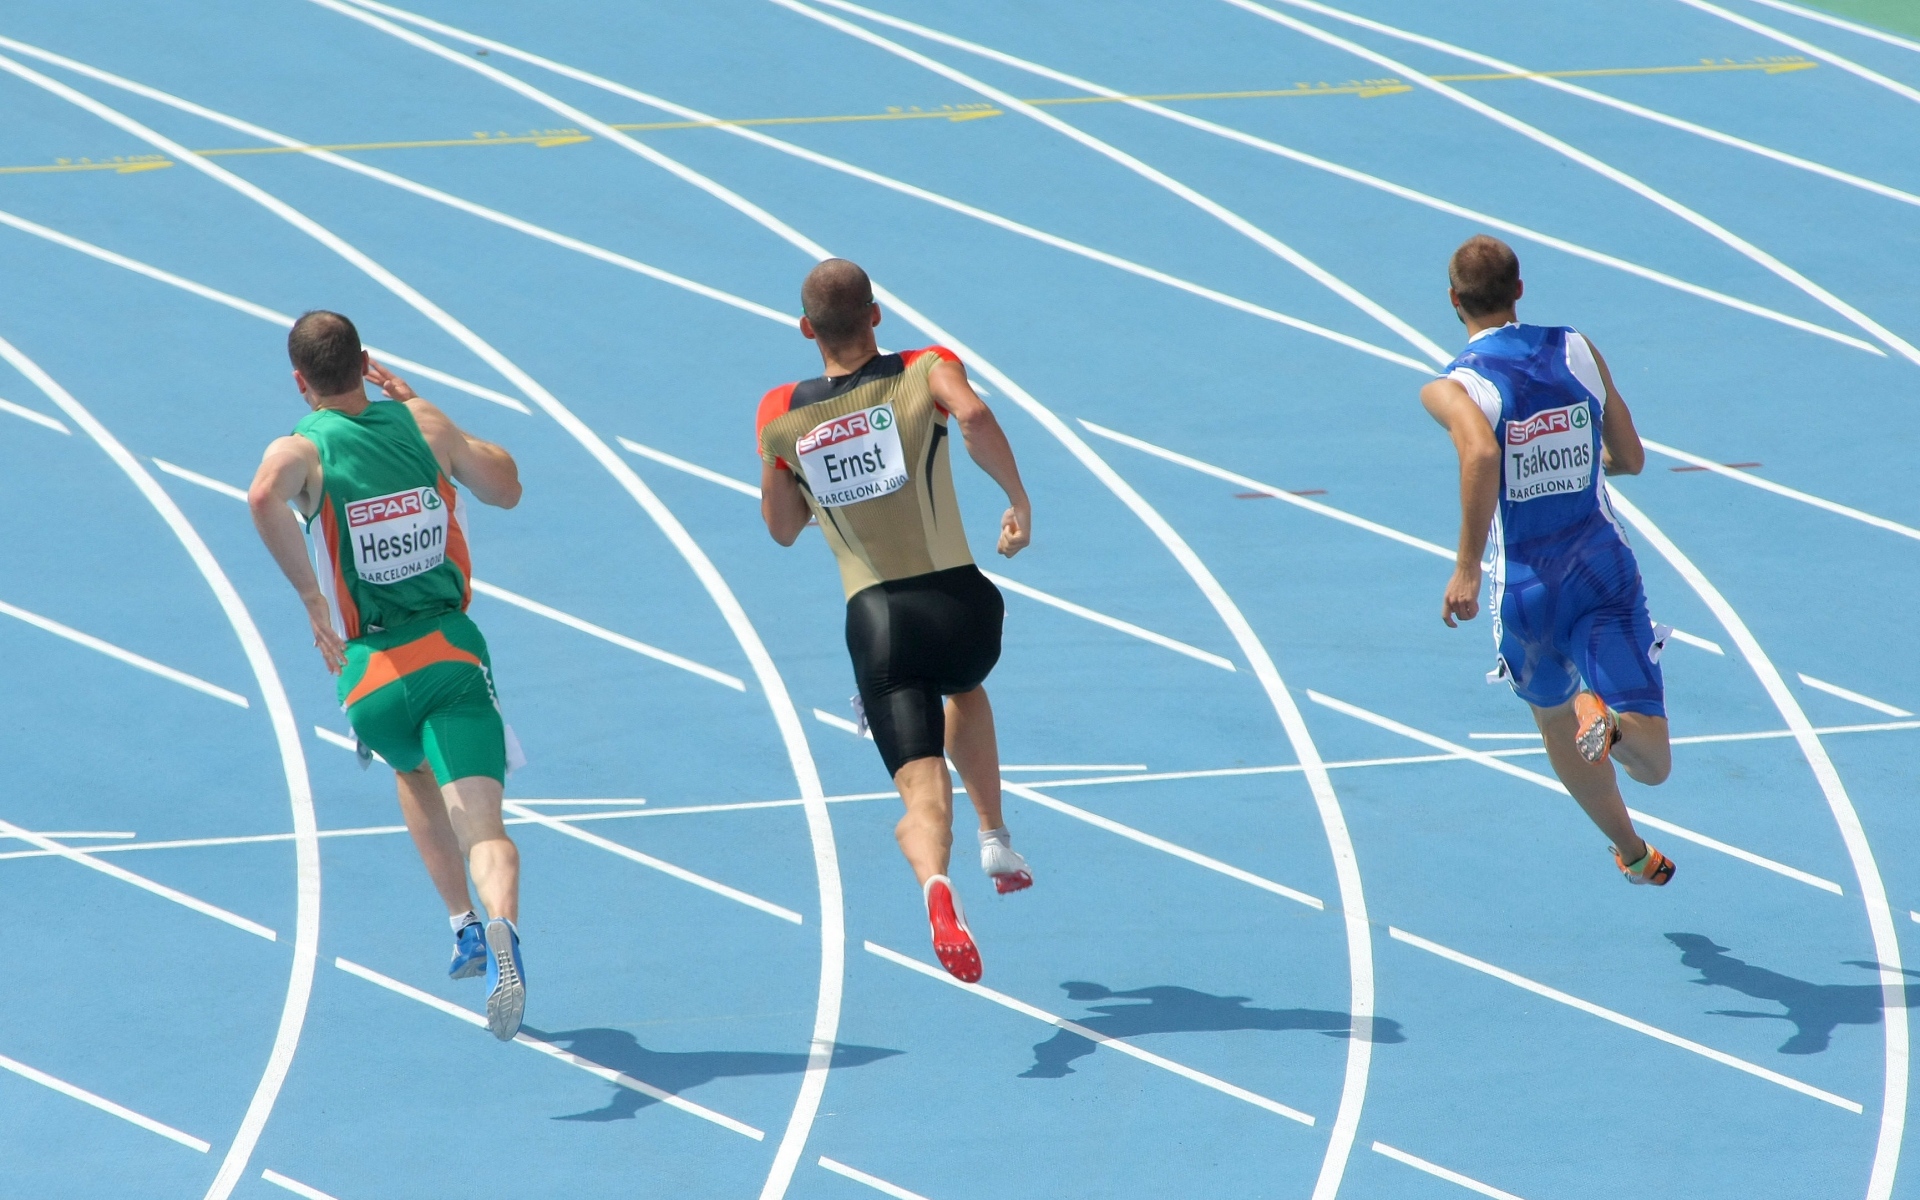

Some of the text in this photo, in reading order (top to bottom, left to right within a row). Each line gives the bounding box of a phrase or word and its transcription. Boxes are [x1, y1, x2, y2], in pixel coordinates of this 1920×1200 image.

[799, 416, 868, 453] SPAR
[1509, 413, 1568, 443] SPAR
[823, 442, 886, 483] Ernst
[1512, 442, 1590, 480] Tsákonas
[817, 474, 907, 506] BARCELONA 2010
[1509, 479, 1574, 499] BARCELONA
[350, 494, 420, 525] SPAR
[360, 523, 443, 564] Hession
